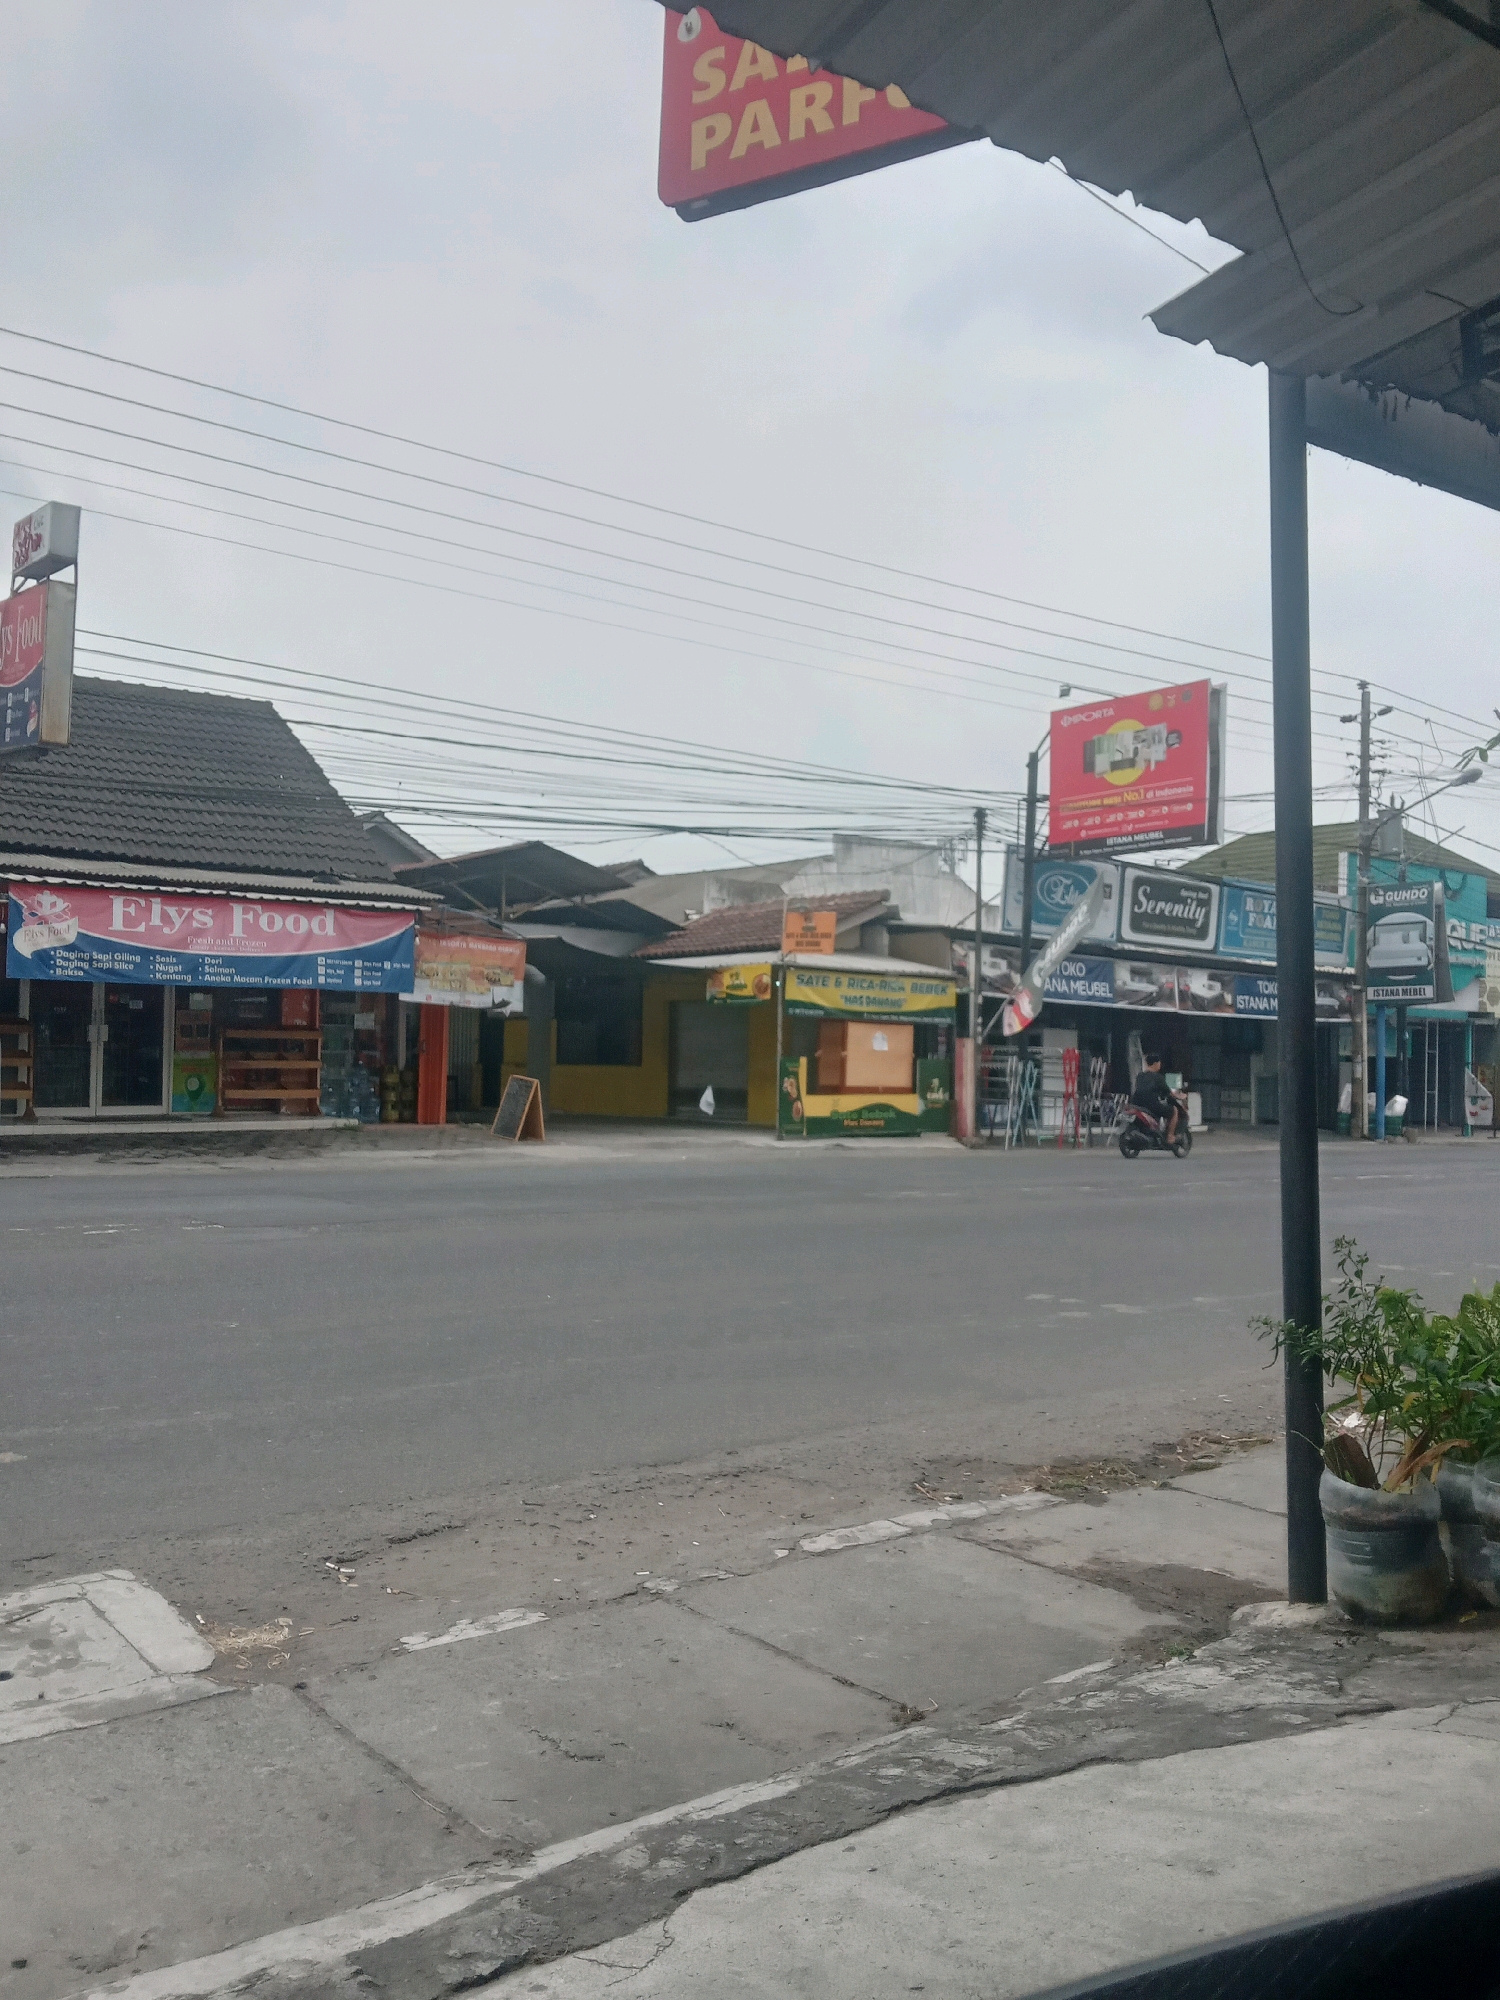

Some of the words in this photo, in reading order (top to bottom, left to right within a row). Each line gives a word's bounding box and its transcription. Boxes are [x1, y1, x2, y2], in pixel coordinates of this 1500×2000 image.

[15, 592, 43, 663] Food
[1124, 789, 1145, 802] No.1
[1134, 885, 1206, 928] Serenity
[108, 895, 214, 935] Elys
[228, 902, 336, 938] Food
[187, 935, 214, 945] Fresh
[216, 937, 233, 945] and
[236, 938, 267, 948] Frozen
[56, 950, 90, 960] Daging
[92, 951, 112, 961] Sapi
[114, 952, 141, 963] Giling
[155, 955, 177, 964] Sosis
[204, 956, 222, 965] Dori
[56, 959, 90, 969] Daging
[92, 960, 112, 970] Sapi
[114, 961, 134, 970] Slice
[155, 964, 182, 973] Nuget
[204, 965, 236, 974] Salmon
[56, 968, 84, 976] Bakso
[155, 972, 192, 982] Kentang
[204, 974, 231, 983] Aneka
[233, 975, 263, 984] Macam
[264, 976, 291, 985] Frozen
[293, 977, 313, 986] Food
[796, 973, 830, 988] SATE
[1044, 977, 1069, 994] ANA
[1070, 979, 1113, 998] MEUBEL
[1373, 988, 1400, 998] ISTANA
[1401, 986, 1427, 997] MEBEL
[1236, 994, 1269, 1011] ISTANA
